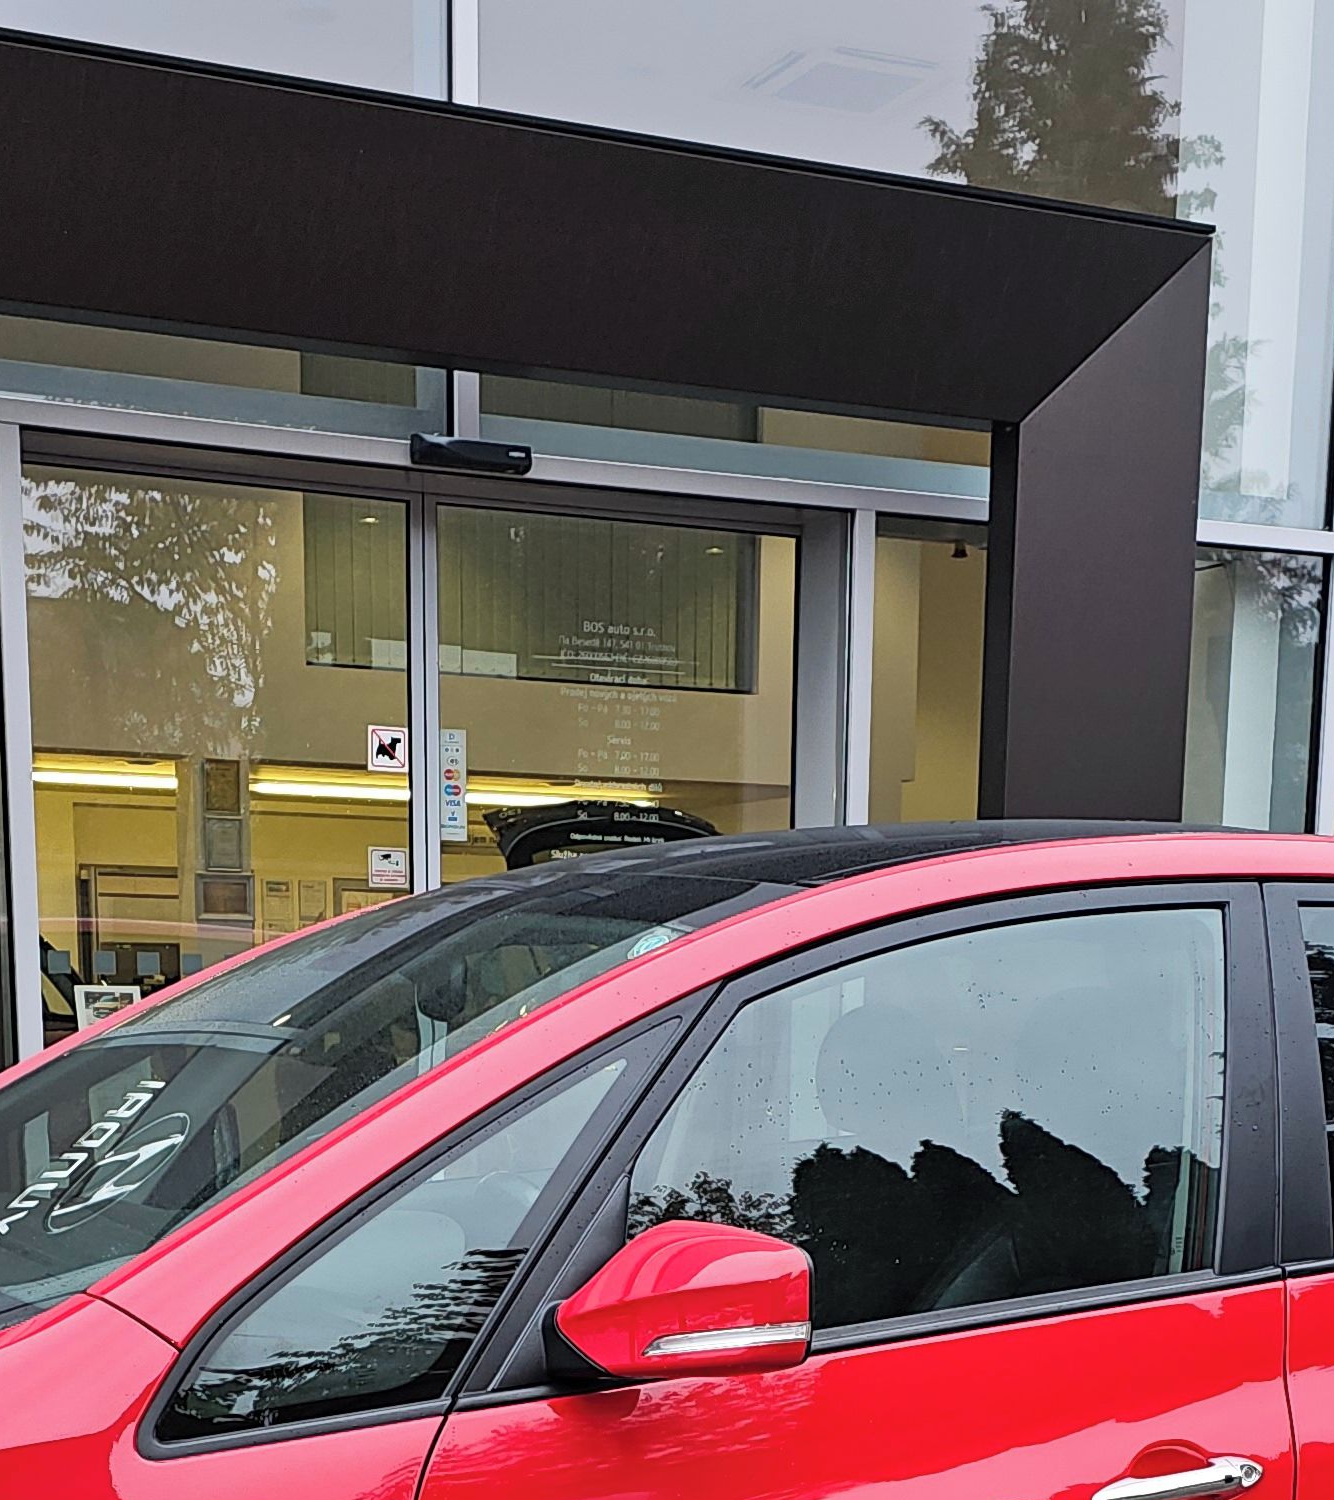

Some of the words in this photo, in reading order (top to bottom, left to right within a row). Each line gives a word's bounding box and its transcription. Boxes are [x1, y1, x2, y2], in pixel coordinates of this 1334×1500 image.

[583, 621, 604, 634] BOS
[607, 624, 630, 636] auto
[633, 627, 656, 638] s.r.o.
[606, 735, 632, 745] Servis
[446, 799, 461, 807] VISA
